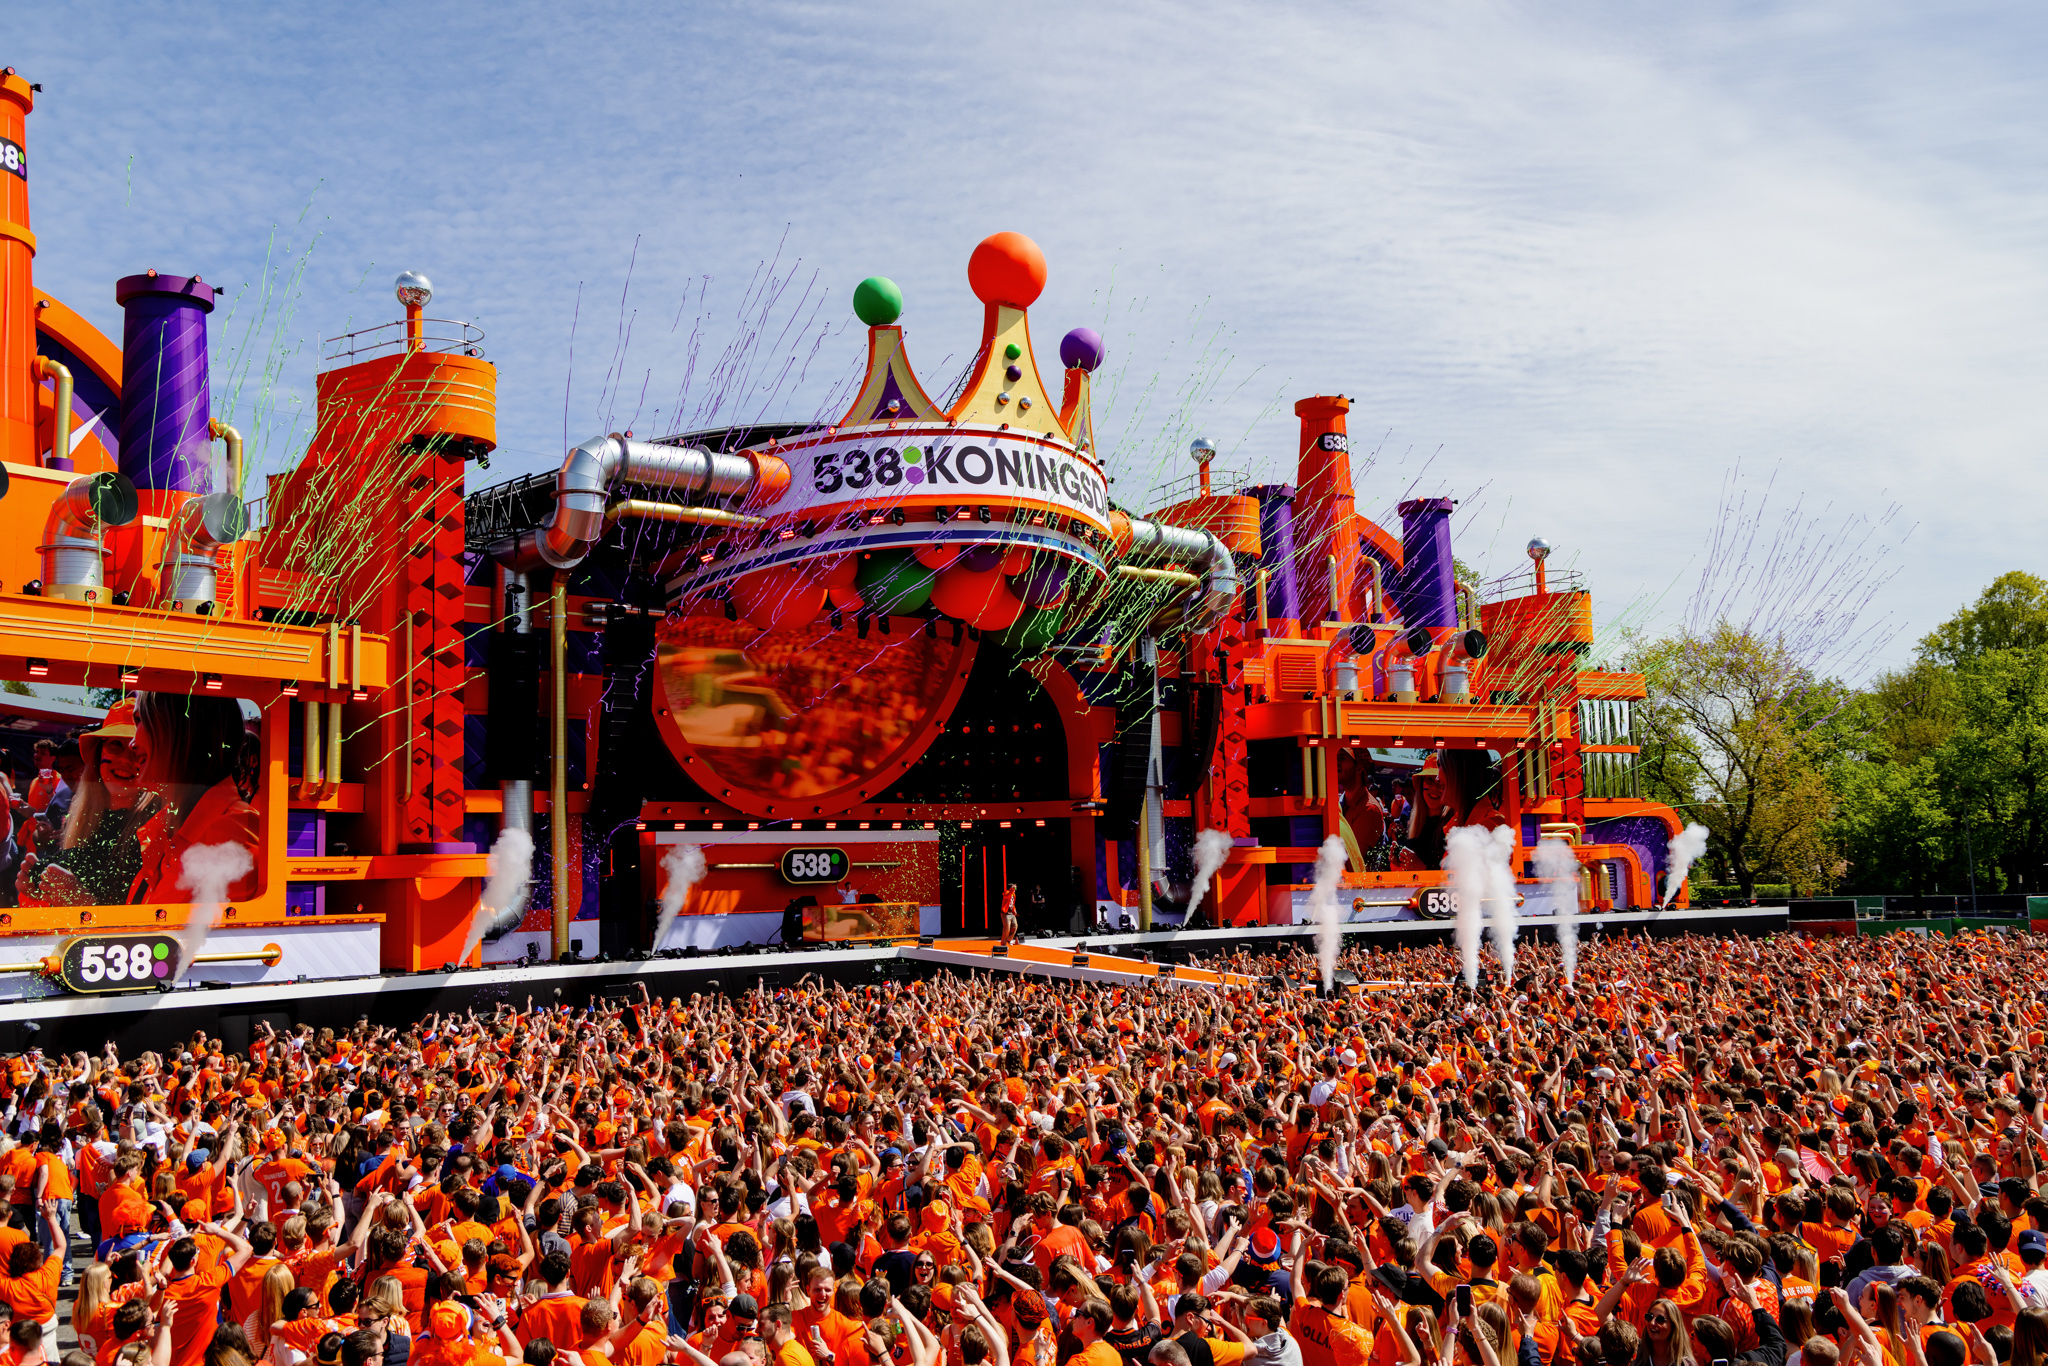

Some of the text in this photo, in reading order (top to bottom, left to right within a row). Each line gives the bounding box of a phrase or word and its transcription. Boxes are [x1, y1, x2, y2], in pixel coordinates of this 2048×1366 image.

[1323, 435, 1347, 451] 538
[923, 445, 1110, 523] KONINGSD
[791, 853, 831, 877] 538
[1427, 892, 1461, 913] 538
[81, 943, 152, 983] 538
[271, 1181, 284, 1204] 2
[1300, 1322, 1334, 1351] OLLA
